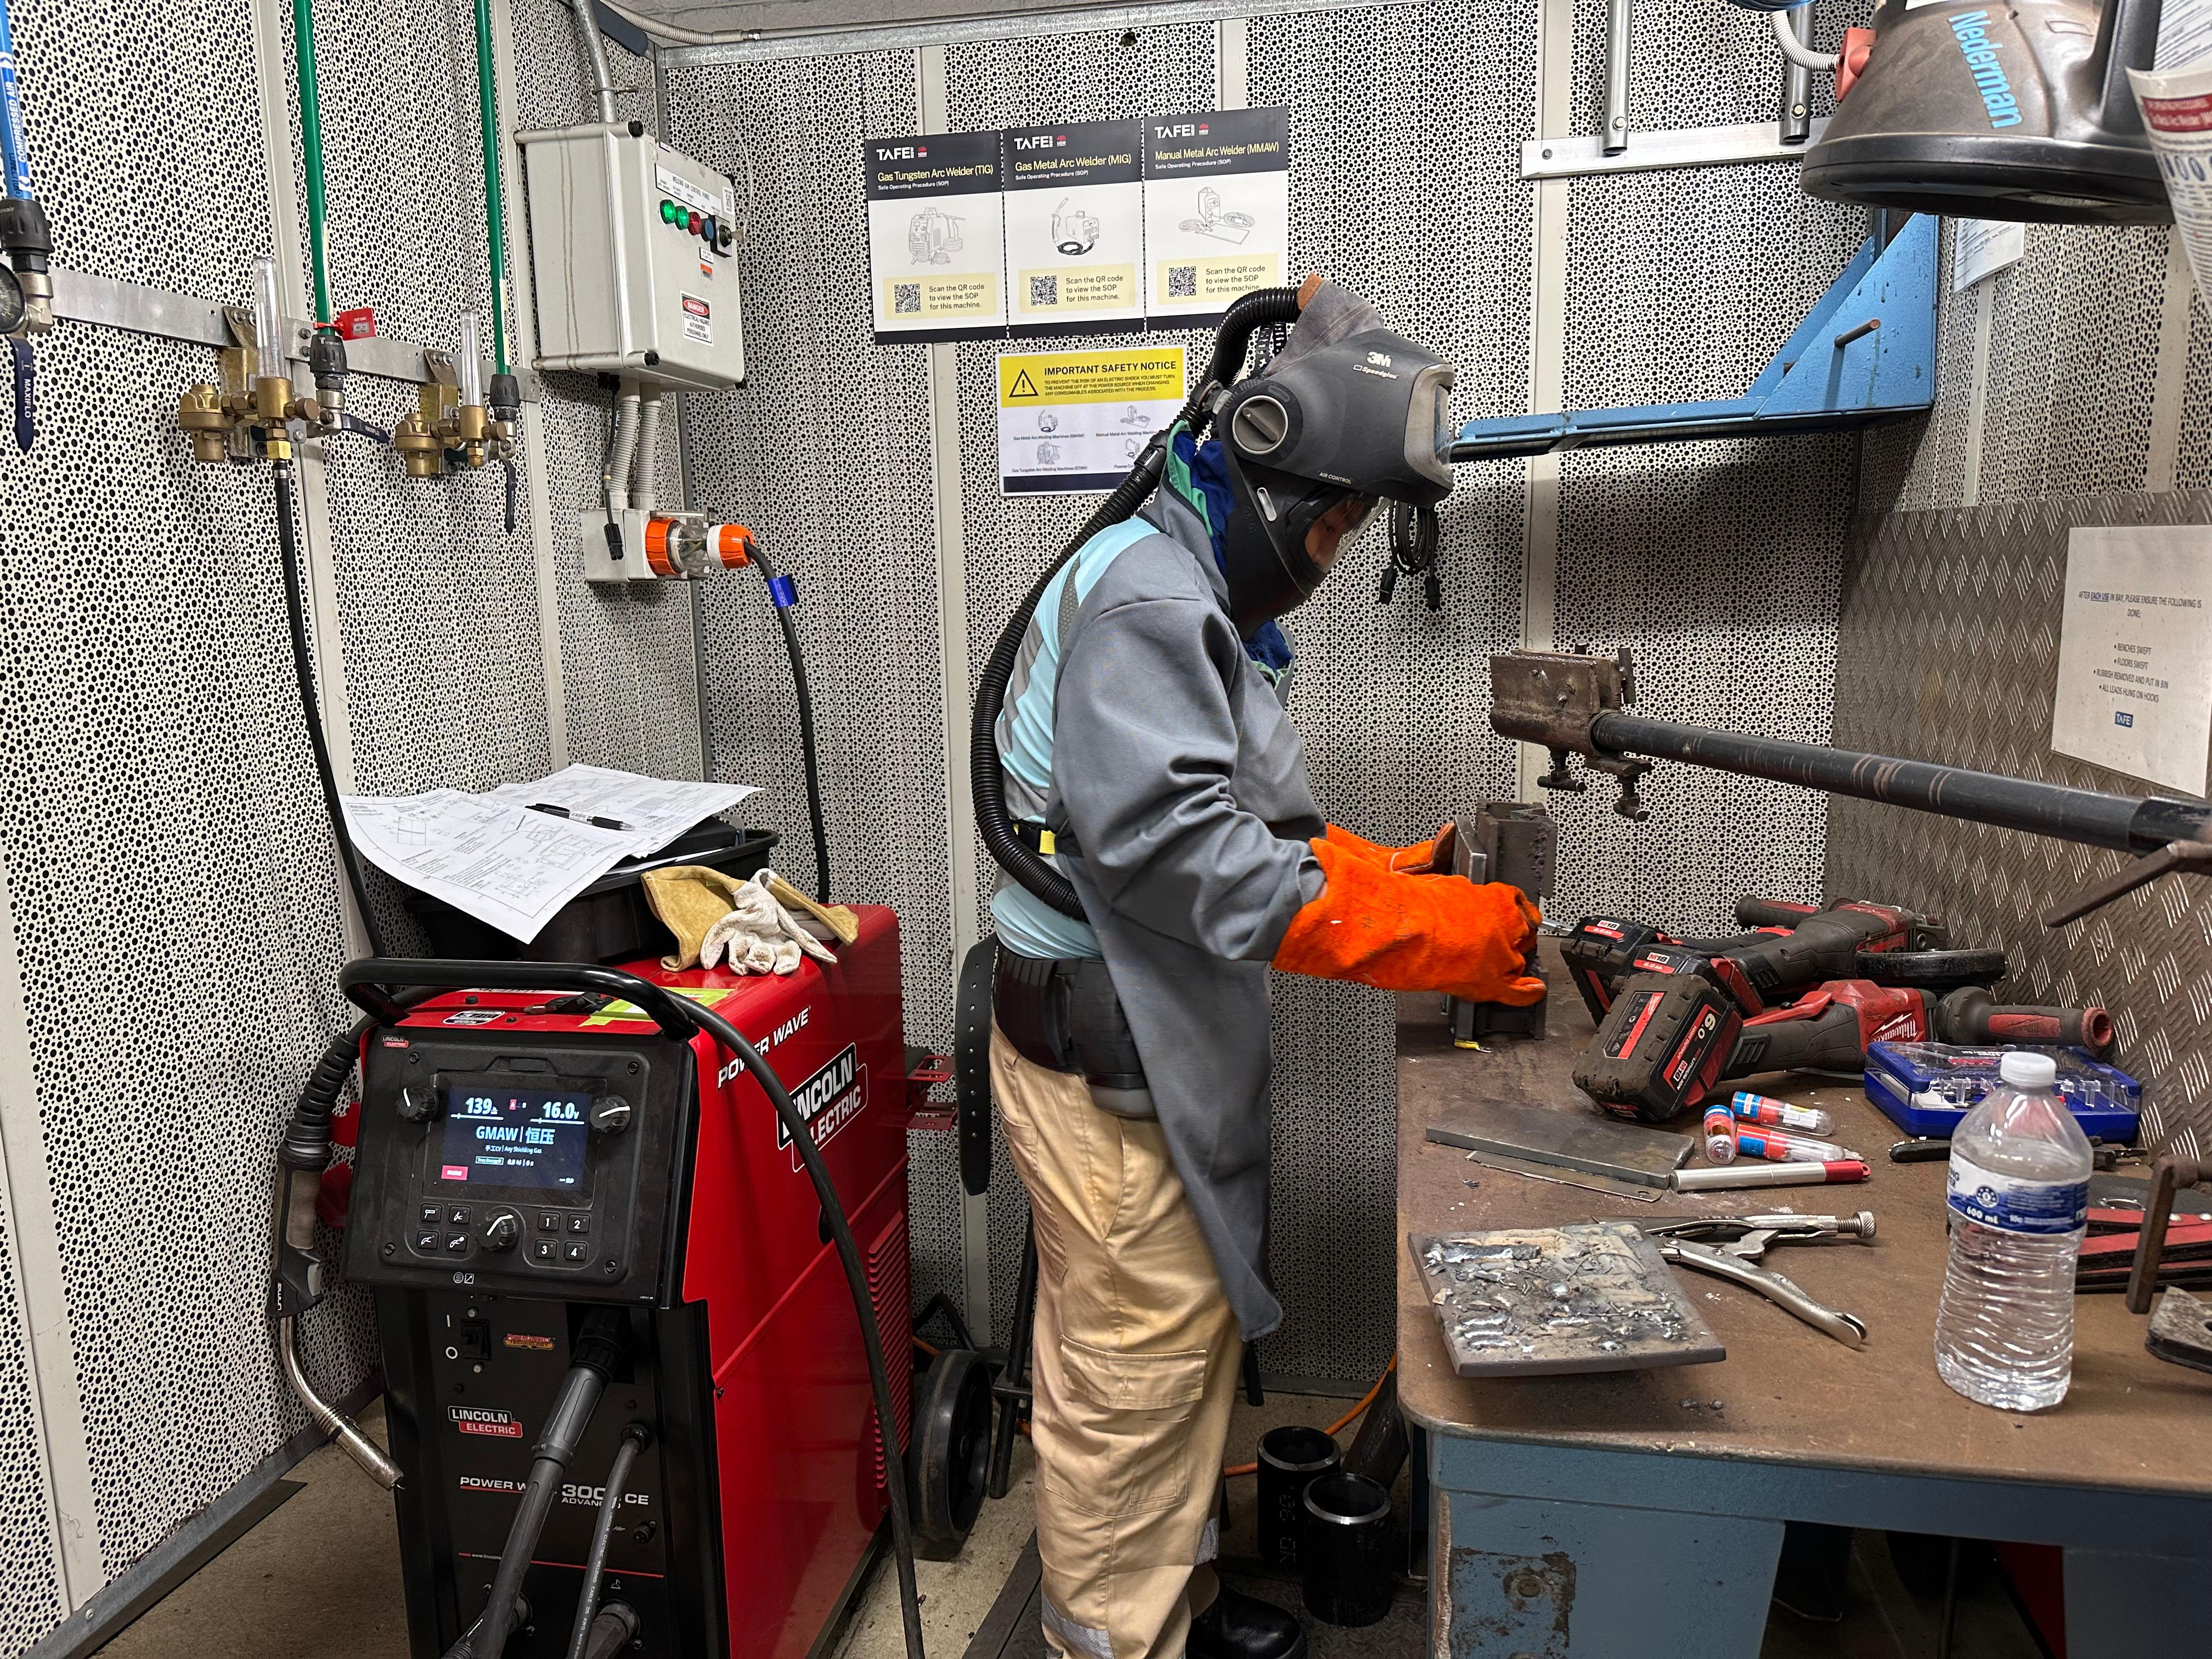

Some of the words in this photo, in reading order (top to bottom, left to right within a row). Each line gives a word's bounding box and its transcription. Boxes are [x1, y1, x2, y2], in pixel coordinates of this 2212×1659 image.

[1948, 10, 2023, 129] Nederman
[6, 81, 16, 98] AIR
[9, 99, 26, 163] COMPRESSED
[1154, 124, 1190, 139] TAFE
[1014, 136, 1049, 150] TAFE
[1155, 150, 1182, 160] Manual
[1183, 148, 1204, 158] Metal
[1205, 147, 1219, 156] Arc
[1220, 144, 1246, 155] Welder
[1247, 142, 1279, 155] (MMAW)
[876, 146, 910, 160] TAFE
[1015, 162, 1032, 171] Gas
[1034, 159, 1057, 170] Metal
[1059, 159, 1075, 168] Arc
[1075, 156, 1107, 167] Welder
[1108, 154, 1131, 166] (MIG)
[877, 172, 893, 182] Gas
[894, 170, 930, 181] Tungsten
[931, 168, 945, 178] Arc
[946, 166, 974, 177] Welder
[975, 164, 994, 176] (TIG)
[687, 301, 705, 314] DANGER
[1367, 351, 1391, 368] 3M
[1045, 365, 1099, 376] IMPORTANT
[1102, 363, 1138, 373] SAFETY
[1141, 361, 1176, 370] NOTICE
[1362, 366, 1397, 379] Speedglas
[1328, 474, 1352, 484] CONTROL
[2079, 591, 2090, 599] AFTER
[2090, 591, 2101, 600] EACH
[2115, 594, 2124, 602] BAY,
[2125, 594, 2141, 603] PLEASE
[2141, 595, 2158, 605] ENSURE
[2159, 597, 2167, 606] THE
[2168, 597, 2197, 608] FOLLOWING
[2197, 600, 2202, 608] IS
[2127, 608, 2141, 618] DONE;
[2117, 643, 2136, 653] BENCHES
[2136, 646, 2152, 656] SWEPT
[2117, 657, 2133, 667] FLOORS
[2134, 660, 2149, 670] SWEPT
[2096, 668, 2113, 678] RUBBISH
[2114, 671, 2135, 682] REMOVED
[2135, 675, 2145, 684] AND
[2146, 677, 2154, 686] PUT
[2155, 679, 2160, 687] IN
[2160, 680, 2169, 689] BIN
[2109, 686, 2123, 695] LEADS
[2123, 688, 2136, 698] HUNG
[2136, 691, 2143, 699] ON
[2143, 692, 2159, 703] HOOKS
[2116, 714, 2132, 725] TAFE
[1649, 953, 1668, 962] M18
[773, 1007, 809, 1046] WAVE
[1697, 1013, 1716, 1039] 6.0
[1677, 1038, 1690, 1060] OUTPUT
[1674, 1062, 1686, 1080] M18
[465, 1097, 492, 1114] 139
[476, 1126, 518, 1141] GMAW
[525, 1127, 556, 1145] 恒压
[513, 1146, 533, 1154] Shielding
[545, 1217, 550, 1228] 1
[574, 1220, 580, 1229] 2
[1966, 1206, 1983, 1218] 600
[1985, 1215, 1999, 1224] mL
[541, 1245, 548, 1256] 3
[571, 1246, 578, 1257] 4
[452, 1408, 508, 1424] LINCOLN
[466, 1423, 516, 1435] ELECTRIC
[460, 1476, 513, 1491] POWER
[625, 1493, 649, 1505] CE
[605, 1511, 613, 1532] LINCOLN
[599, 1534, 608, 1558] ELECTRIC
[592, 1560, 602, 1583] WELDING
